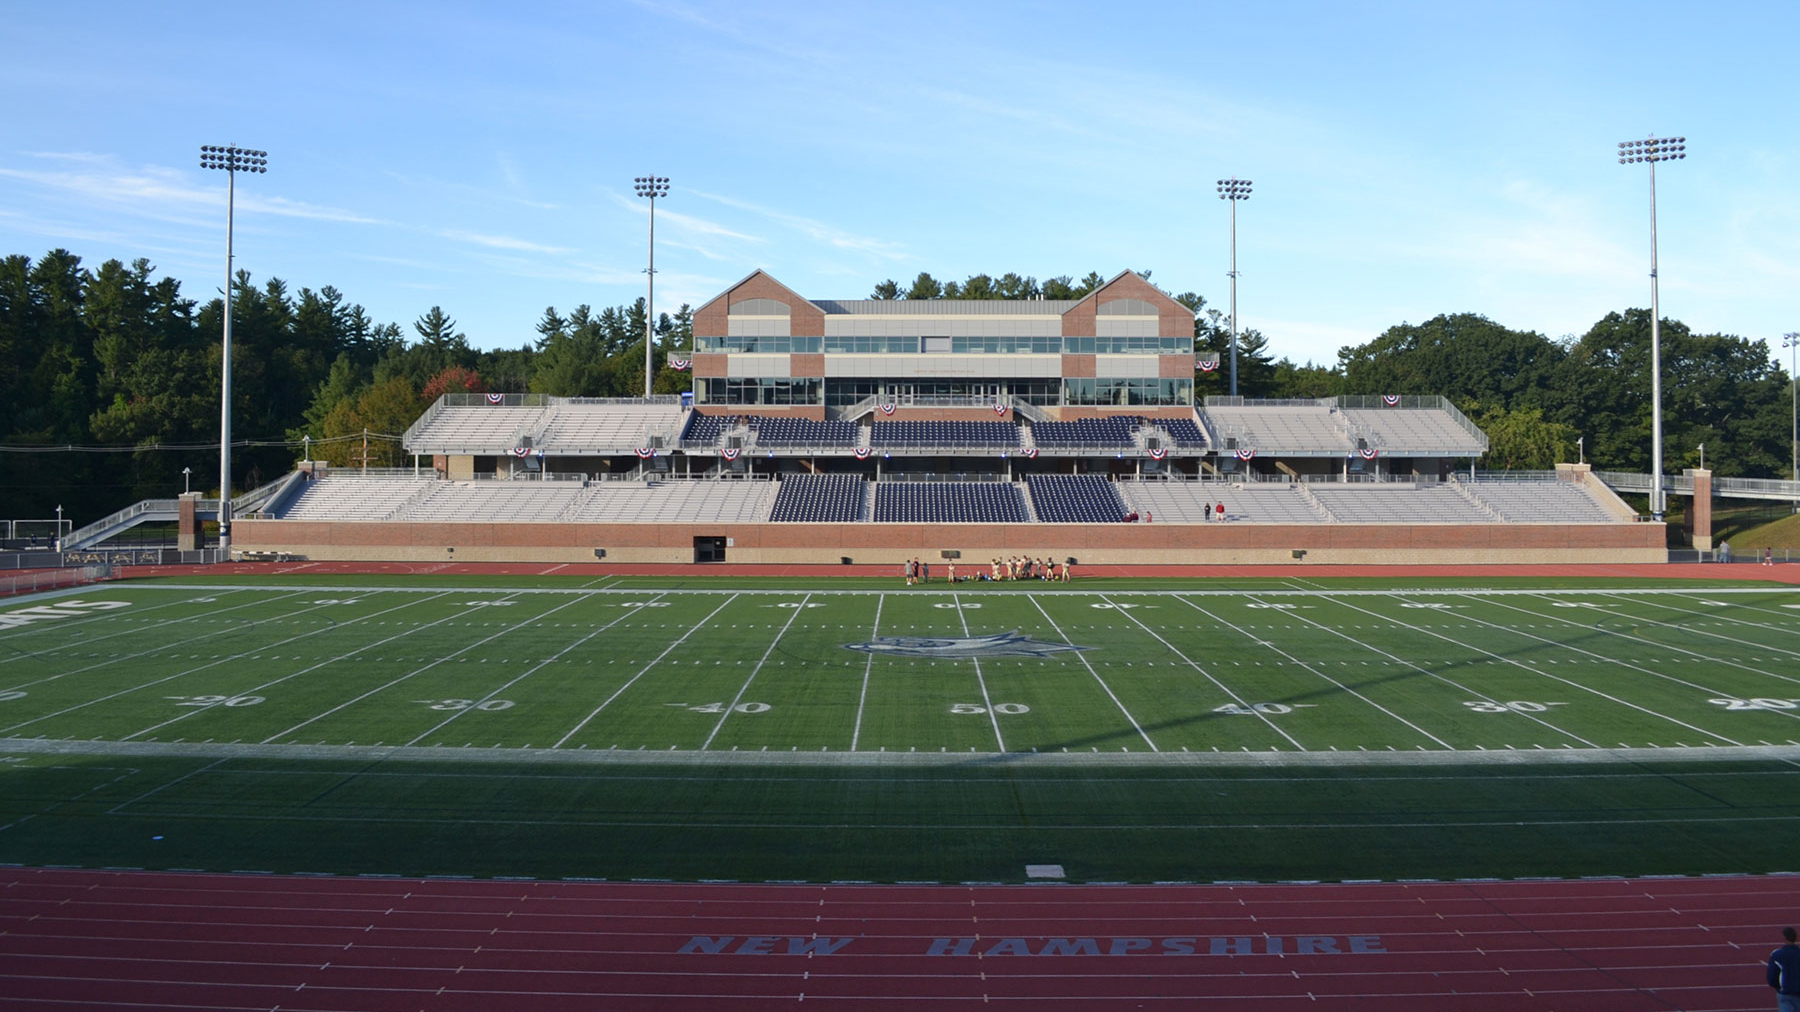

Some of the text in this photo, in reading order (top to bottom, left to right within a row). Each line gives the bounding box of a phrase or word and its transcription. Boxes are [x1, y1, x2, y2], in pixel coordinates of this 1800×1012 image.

[175, 695, 266, 707] 20
[430, 699, 516, 711] 30
[1462, 701, 1548, 713] 30
[1708, 698, 1798, 710] 20
[688, 702, 771, 713] 40
[949, 703, 1030, 714] 50
[1212, 702, 1292, 714] 40
[675, 936, 1388, 956] NEW HAMPSHIRE
